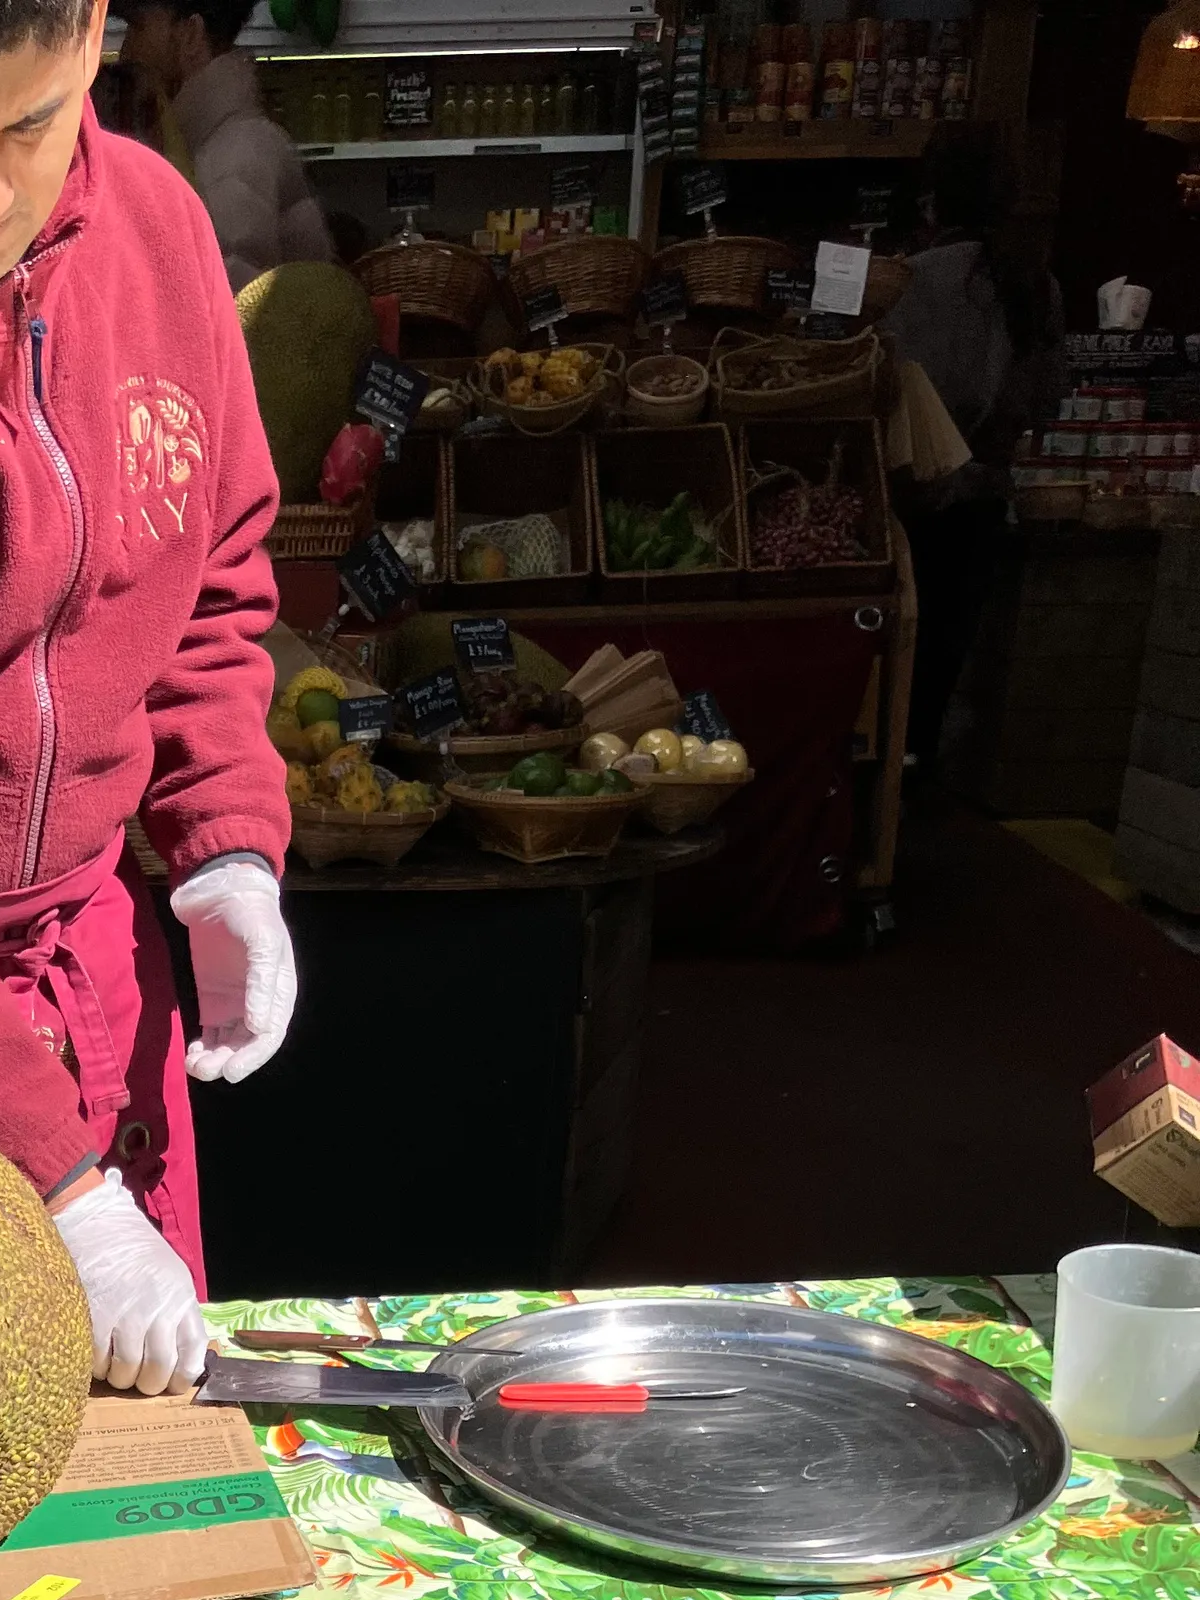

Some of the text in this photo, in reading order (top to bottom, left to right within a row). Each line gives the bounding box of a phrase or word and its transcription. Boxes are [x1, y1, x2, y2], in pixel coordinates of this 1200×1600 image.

[94, 1426, 138, 1435] MINIMAL
[182, 1476, 259, 1489] Powder Free
[71, 1482, 262, 1508] Clear Vinyl Disposable Gloves
[115, 1492, 265, 1525] GD09
